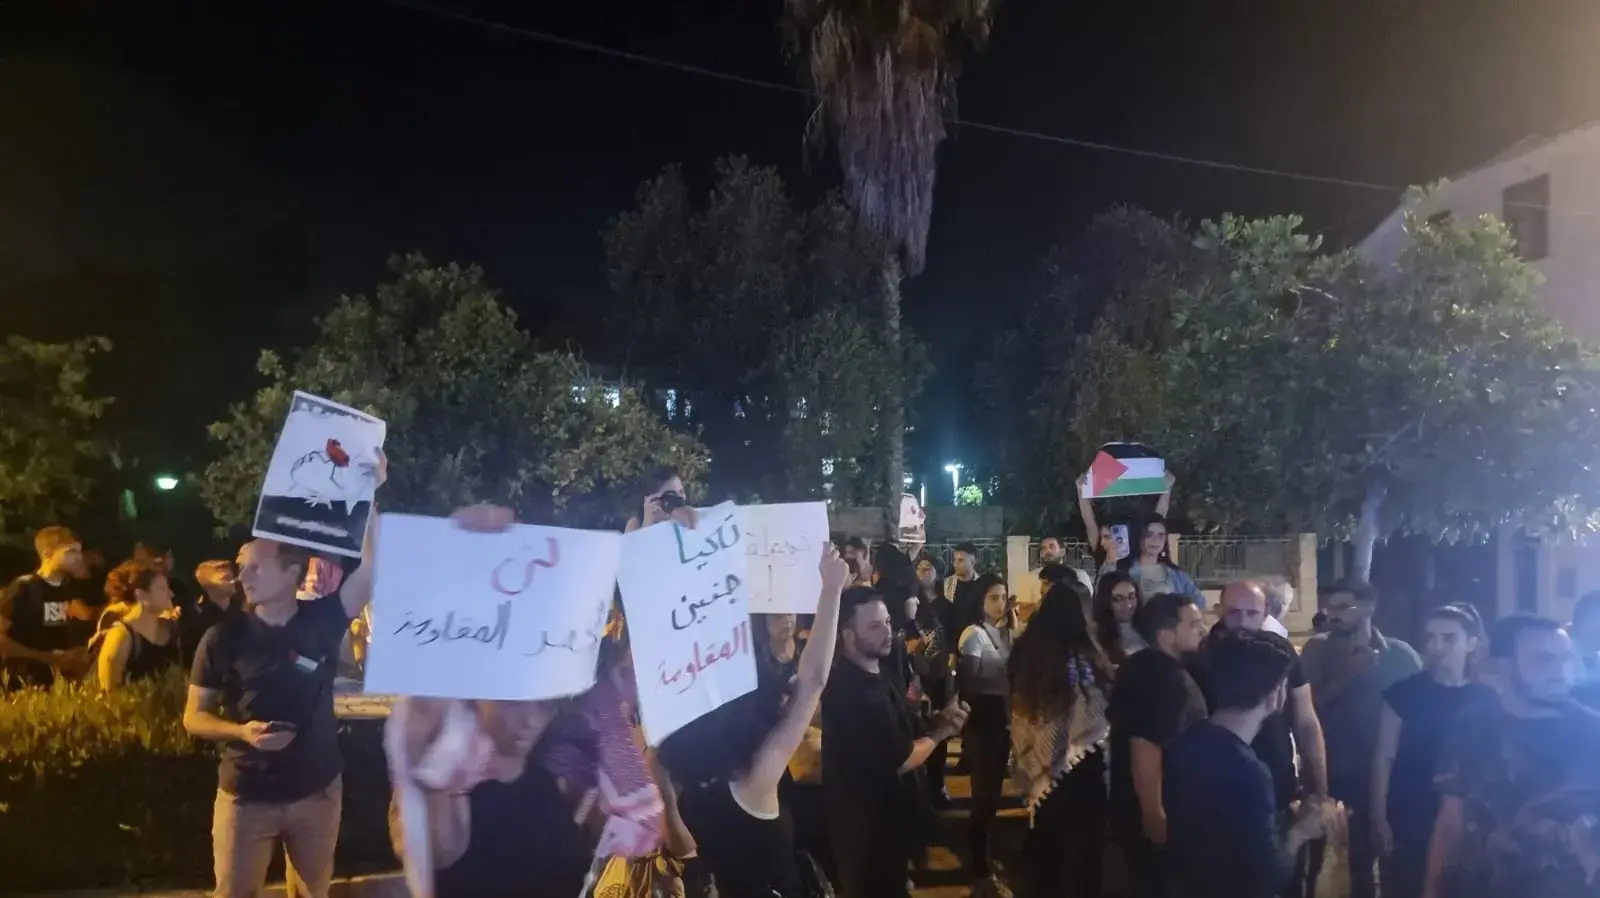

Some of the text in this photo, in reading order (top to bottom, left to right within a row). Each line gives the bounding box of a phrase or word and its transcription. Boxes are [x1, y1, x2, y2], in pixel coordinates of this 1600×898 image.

[491, 537, 560, 596] لن
[674, 514, 740, 570] تحيا
[393, 600, 512, 650] المقاومة
[672, 573, 741, 630] جنين
[656, 620, 748, 695] المقاومة
